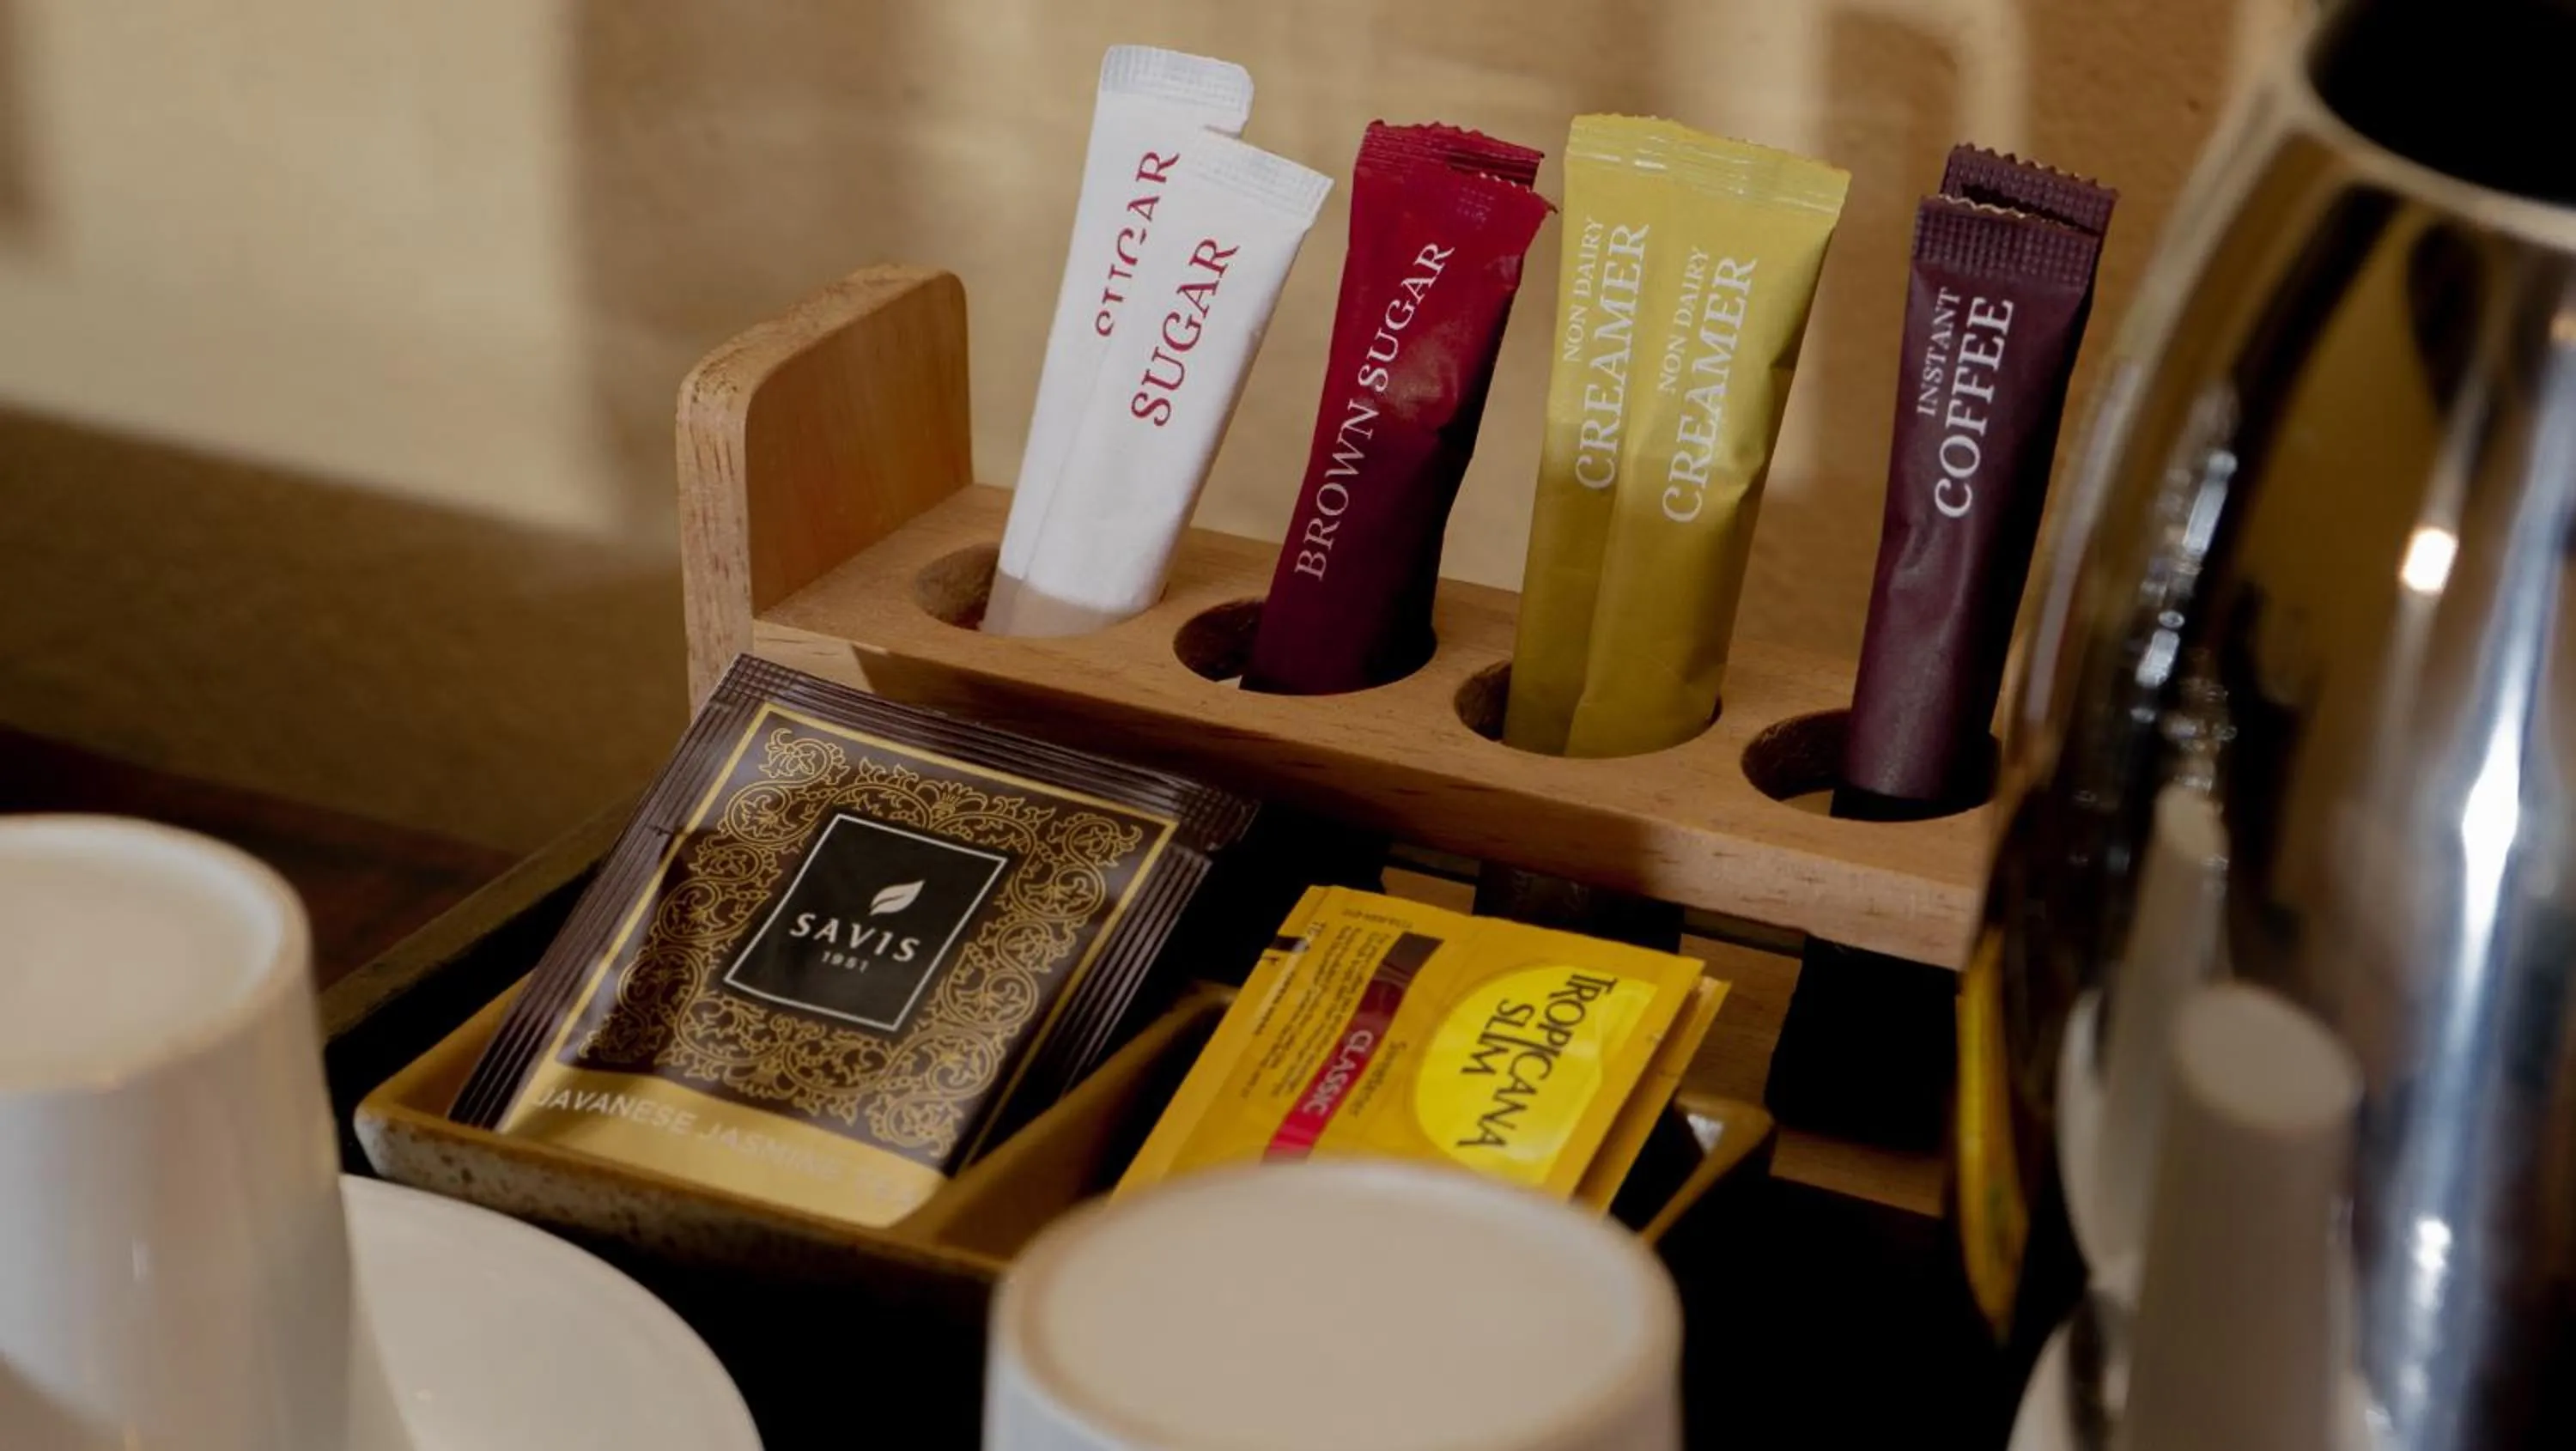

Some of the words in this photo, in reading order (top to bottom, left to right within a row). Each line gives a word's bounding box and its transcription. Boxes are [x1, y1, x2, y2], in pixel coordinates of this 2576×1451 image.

[1573, 215, 1605, 294] DAIRY
[1657, 331, 1686, 395] NON
[1674, 245, 1710, 328] DAIRY
[1130, 237, 1241, 428] SUGAR
[1563, 301, 1589, 362] NON
[1575, 223, 1650, 490] CREAMER
[1662, 257, 1758, 523] CREAMER
[1916, 286, 1961, 417] INSTANT
[1294, 398, 1380, 582] BROWN
[1358, 242, 1455, 394] SUGAR
[1934, 296, 2014, 519] COFFEE
[789, 912, 921, 963] SAVIS
[1303, 1029, 1374, 1115] CLASSIC
[1456, 971, 1619, 1147] TROPICANA
[1459, 998, 1537, 1075] SLIM
[535, 1088, 697, 1135] JAVANESE
